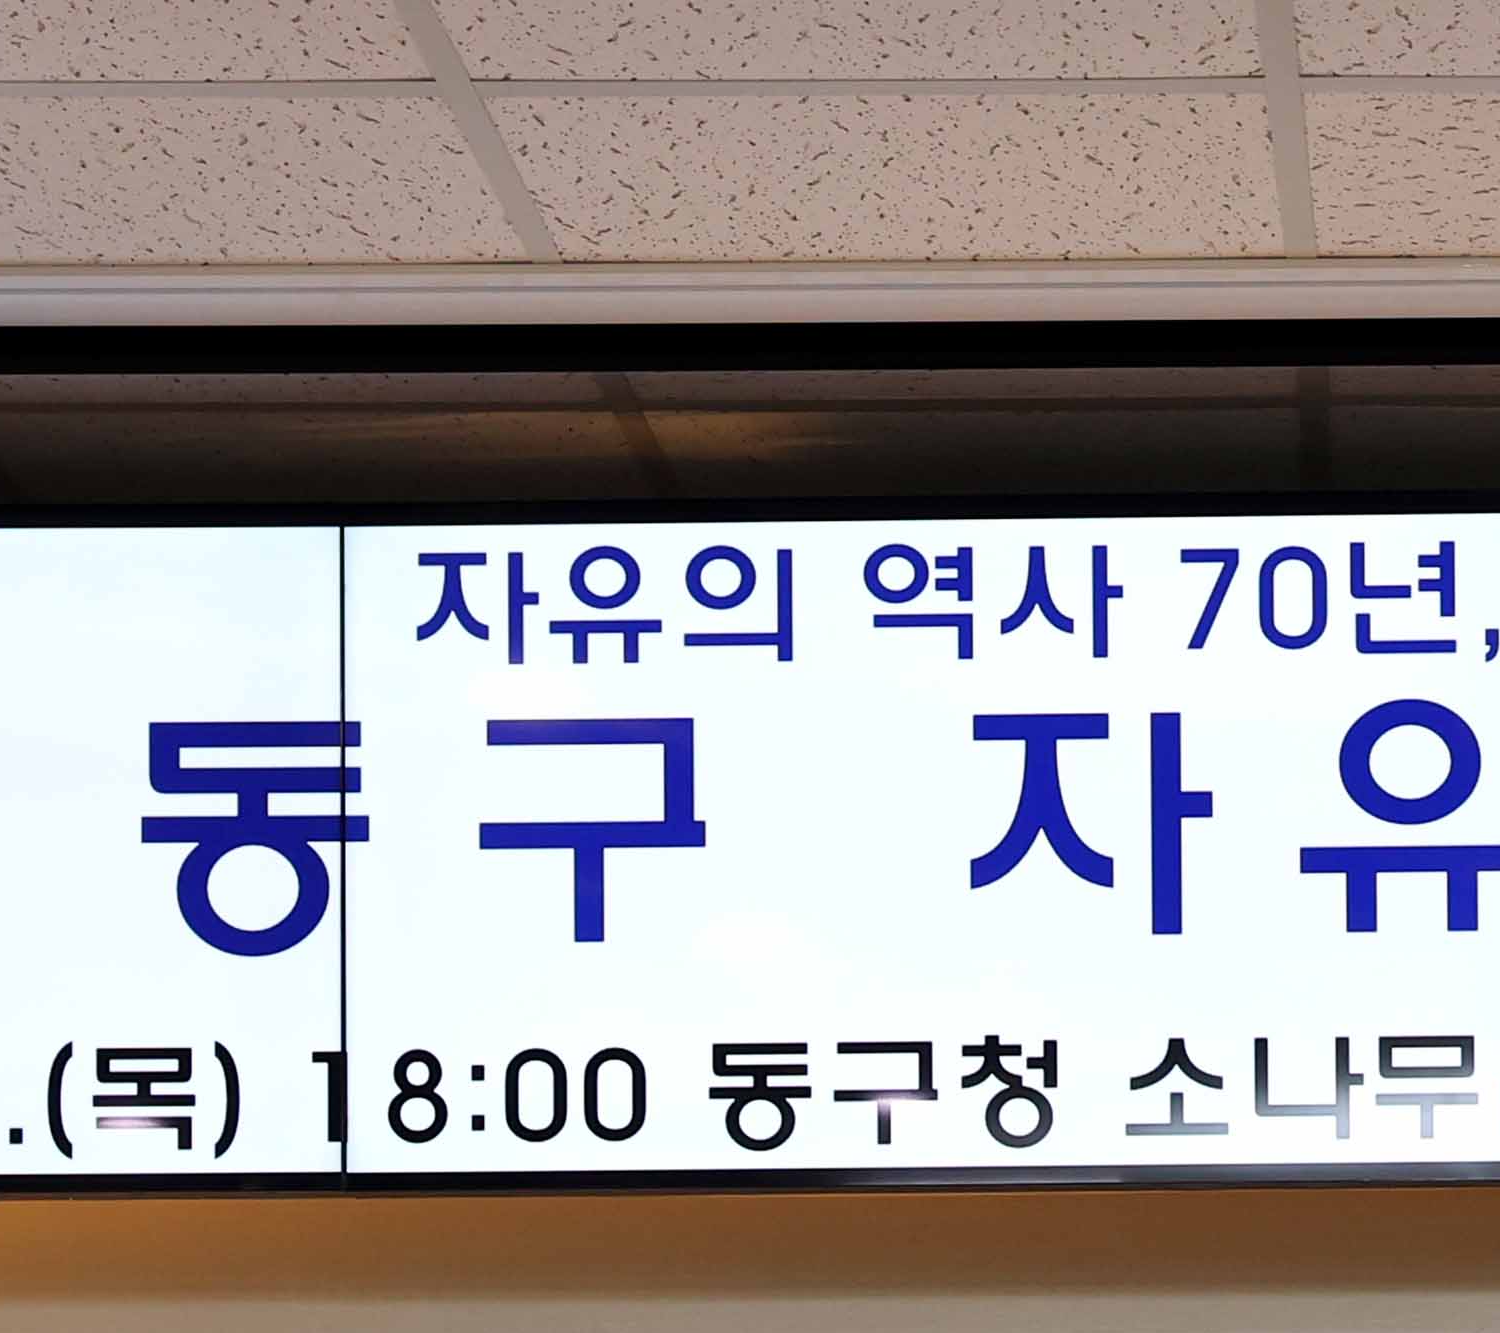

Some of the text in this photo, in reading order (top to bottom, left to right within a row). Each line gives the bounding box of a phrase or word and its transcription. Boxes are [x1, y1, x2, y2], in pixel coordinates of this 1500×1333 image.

[417, 546, 793, 664] 자유의
[864, 544, 1123, 659] 역사
[1181, 541, 1499, 661] 70년,
[142, 718, 705, 956] 동구
[312, 1048, 646, 1143] 18:00
[709, 1035, 1057, 1151] 동구청
